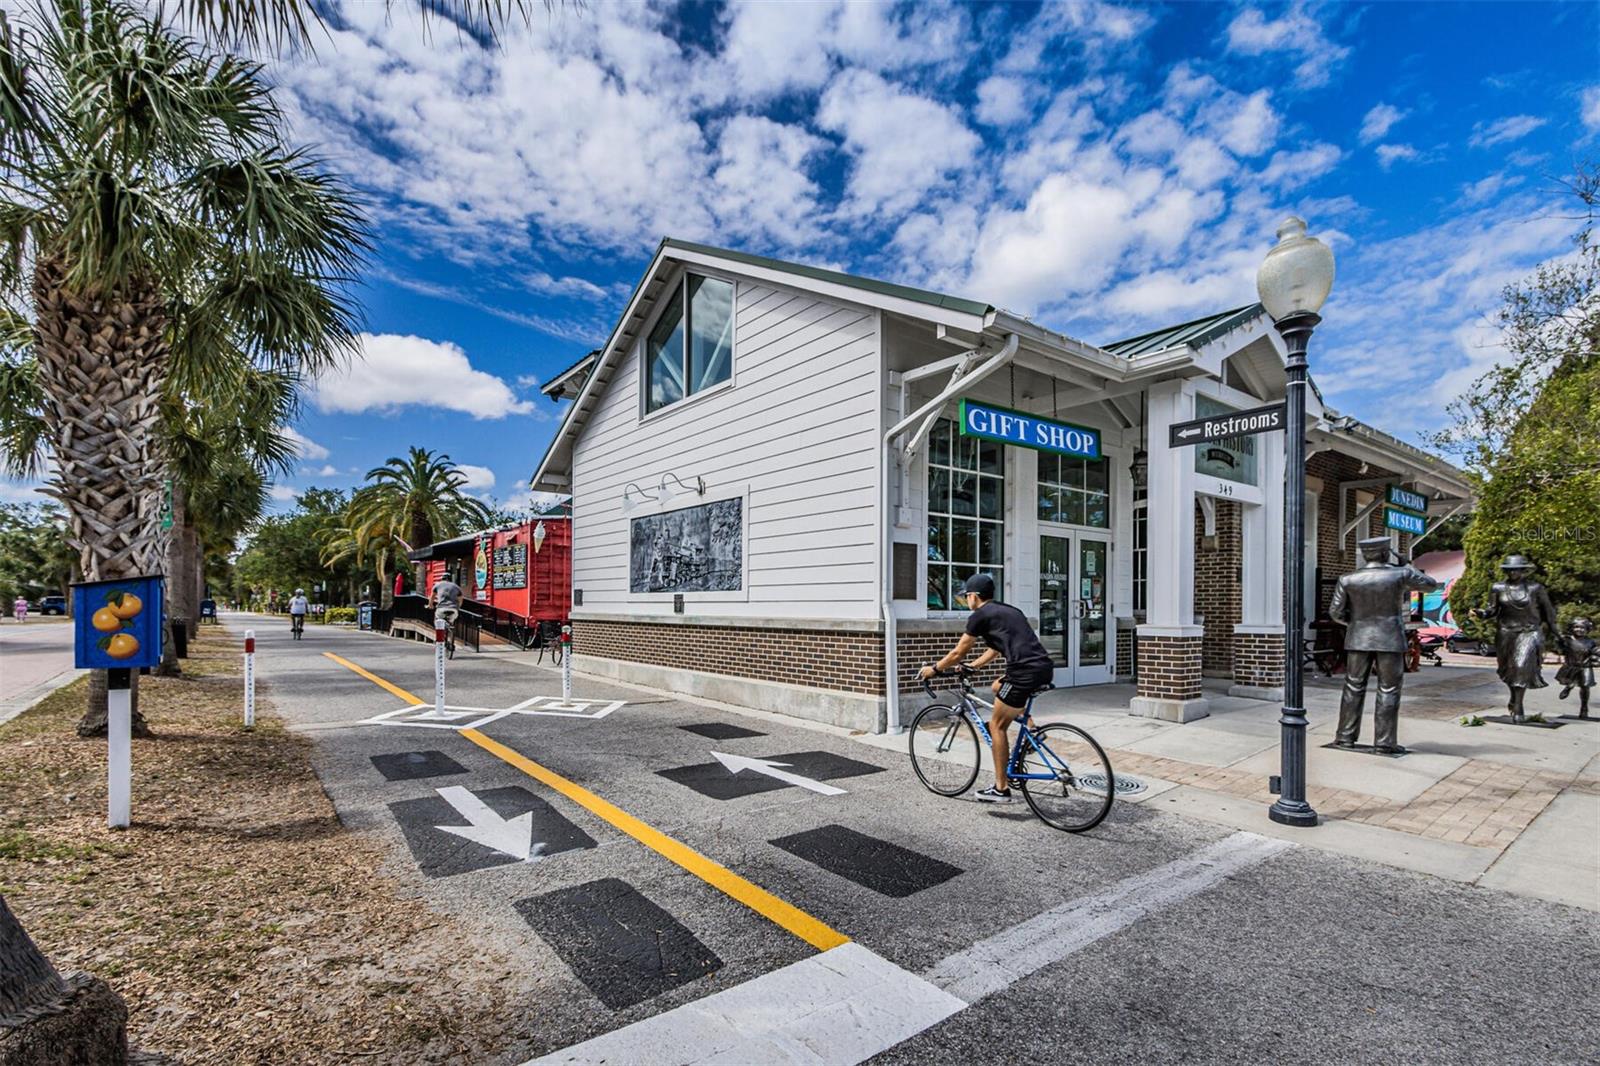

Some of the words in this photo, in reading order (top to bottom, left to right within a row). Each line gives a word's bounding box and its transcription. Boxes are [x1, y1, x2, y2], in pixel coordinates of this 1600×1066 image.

[968, 408, 1029, 440] GIFT
[1036, 423, 1094, 454] SHOP
[1204, 412, 1279, 438] Restrooms
[1218, 483, 1232, 496] 349
[1388, 511, 1423, 531] MUSEUM
